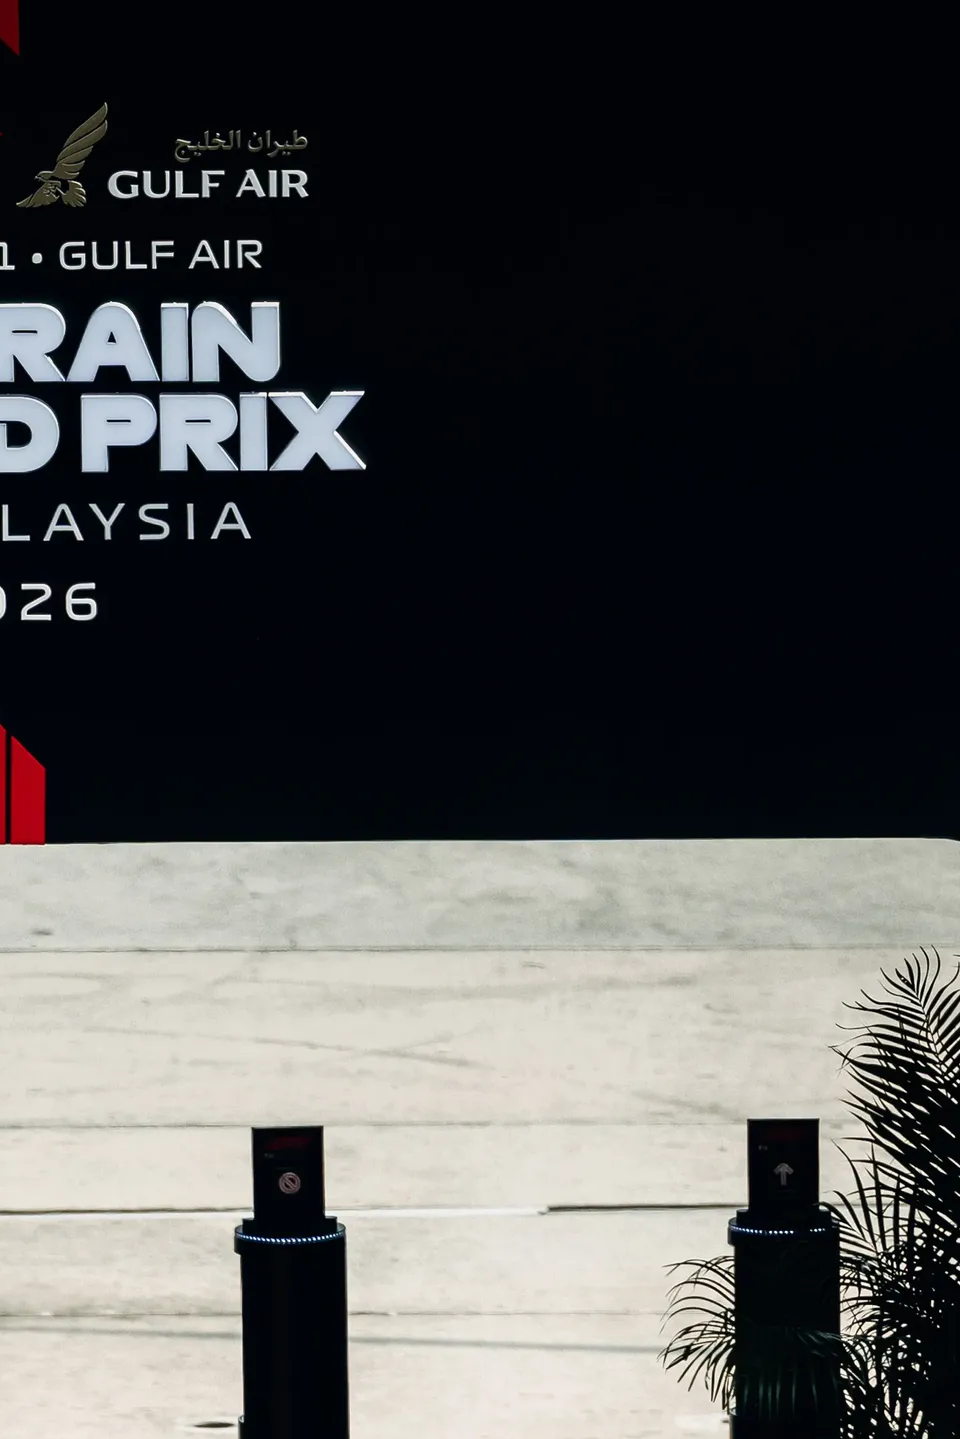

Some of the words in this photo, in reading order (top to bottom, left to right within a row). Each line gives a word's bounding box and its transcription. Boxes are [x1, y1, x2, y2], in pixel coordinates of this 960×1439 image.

[174, 129, 241, 163] الخليج
[247, 129, 308, 158] طيران
[107, 170, 225, 199] GULF
[235, 168, 309, 199] AIR
[58, 240, 175, 271] GULF
[188, 239, 263, 270] AIR
[79, 390, 367, 473] PRIX
